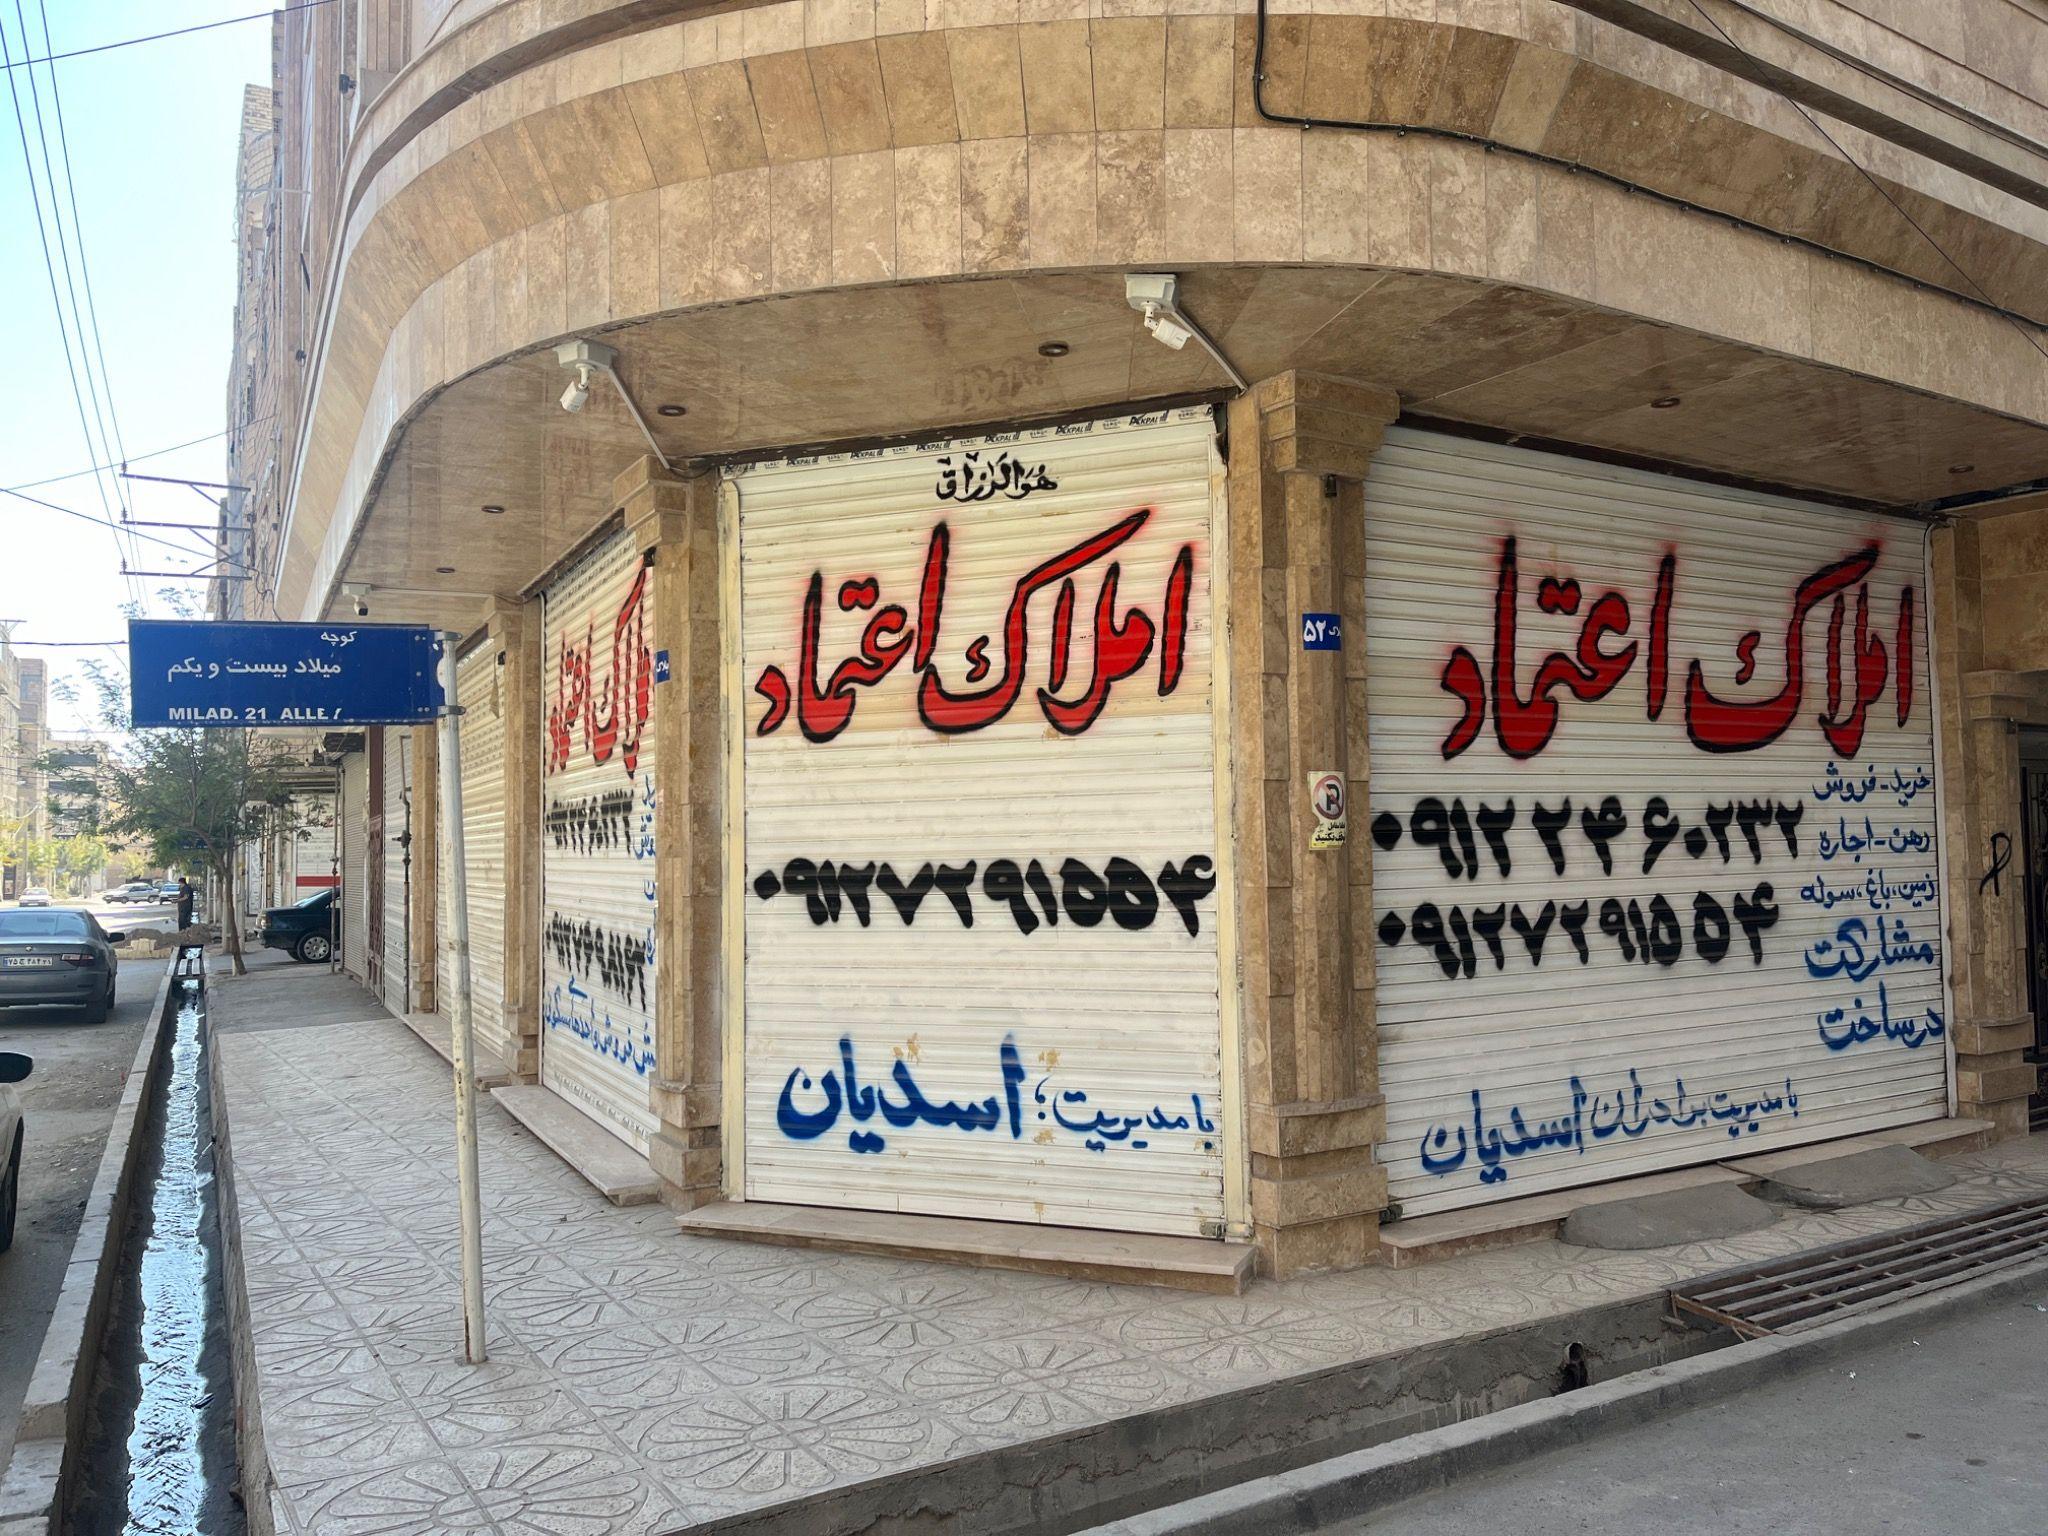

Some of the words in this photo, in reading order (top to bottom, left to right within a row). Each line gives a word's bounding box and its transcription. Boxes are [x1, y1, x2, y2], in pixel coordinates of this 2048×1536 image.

[320, 631, 358, 647] کوچه
[755, 521, 949, 743] اعتماد
[918, 509, 1193, 735] املاک
[1441, 536, 1676, 760] اعتماد
[1685, 543, 1914, 759] املاک
[167, 657, 202, 682] یکم
[208, 662, 220, 680] و
[225, 657, 288, 678] بیست
[294, 658, 342, 678] میلاد
[168, 707, 239, 720] MILAD.
[245, 707, 267, 720] 21
[754, 854, 1216, 938] ۰۹۱۲۷۲۹۱۵۵۴
[1804, 915, 1934, 982] مشارکت
[777, 1033, 1026, 1153] اسدیان
[1420, 1075, 1588, 1184] اسدیان
